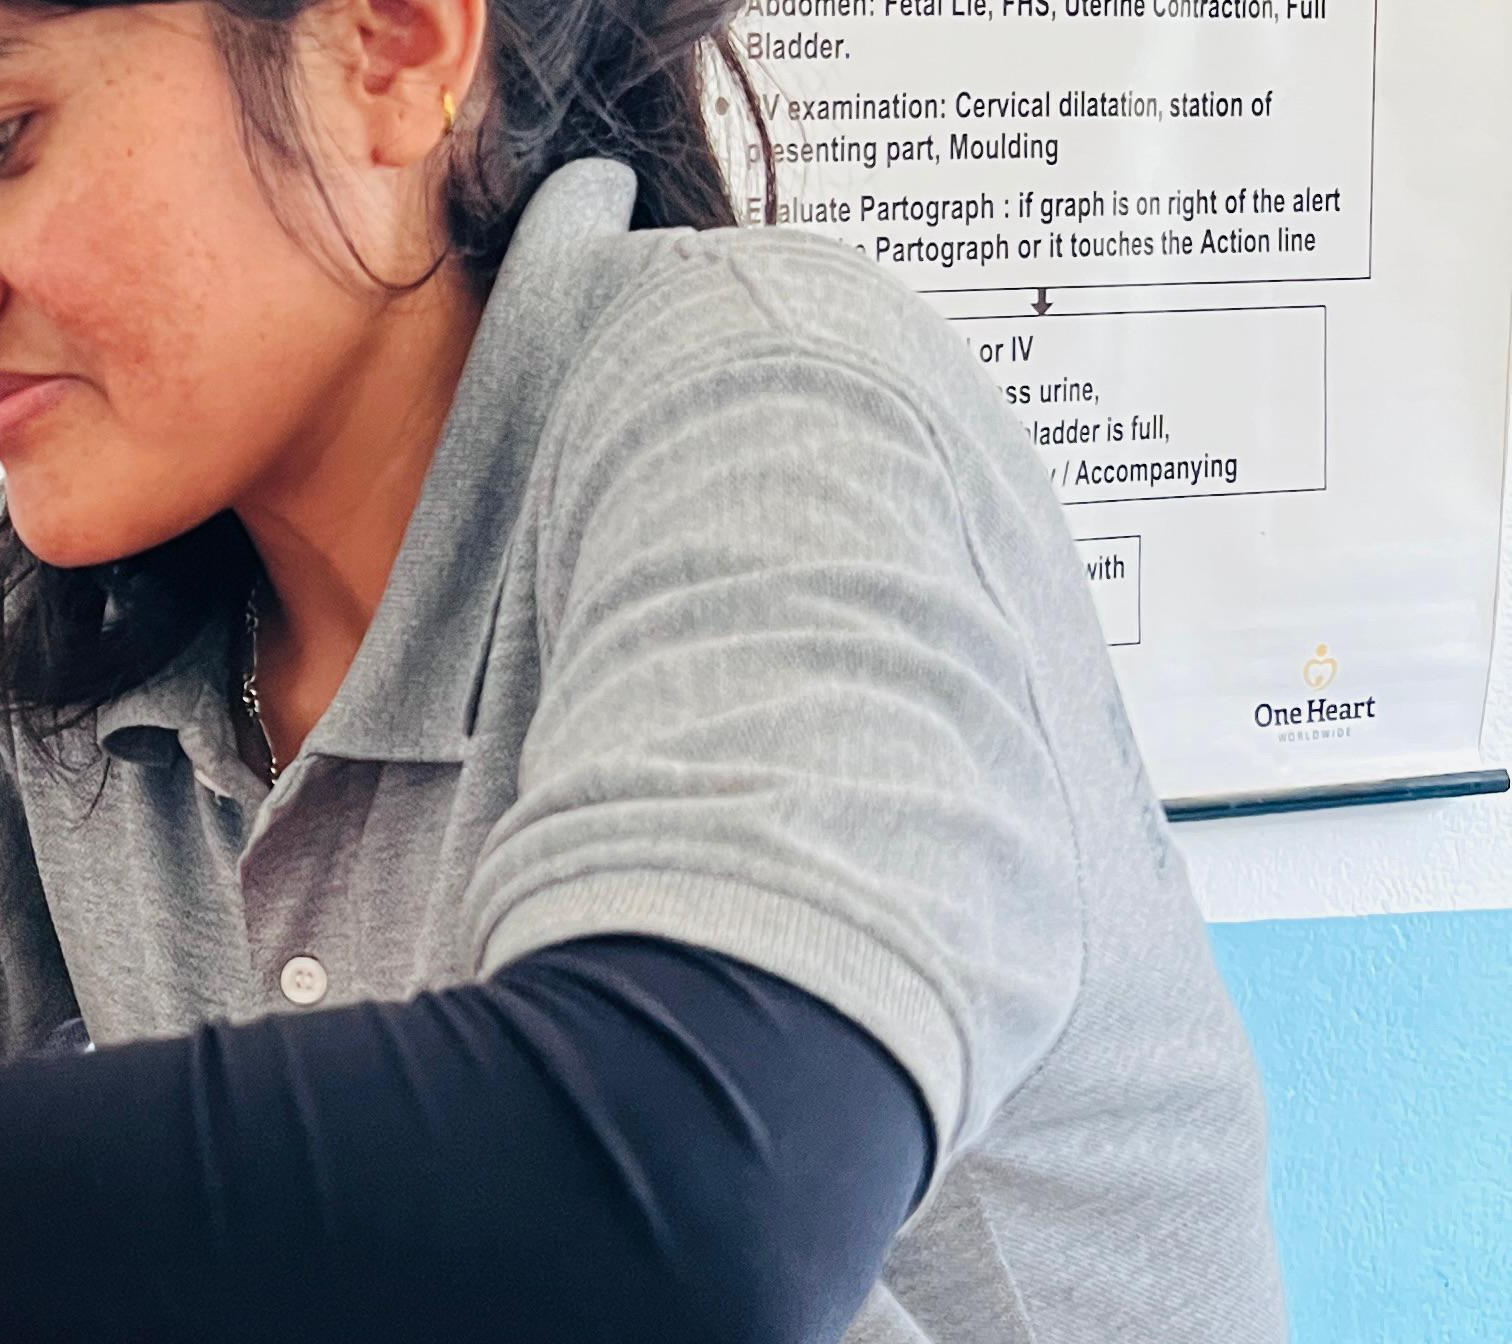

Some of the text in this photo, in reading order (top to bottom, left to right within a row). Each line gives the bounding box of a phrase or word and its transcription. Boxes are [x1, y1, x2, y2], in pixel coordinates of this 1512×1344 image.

[1255, 697, 1375, 727] One Heart
[1278, 726, 1352, 742] WORLDWIDE
